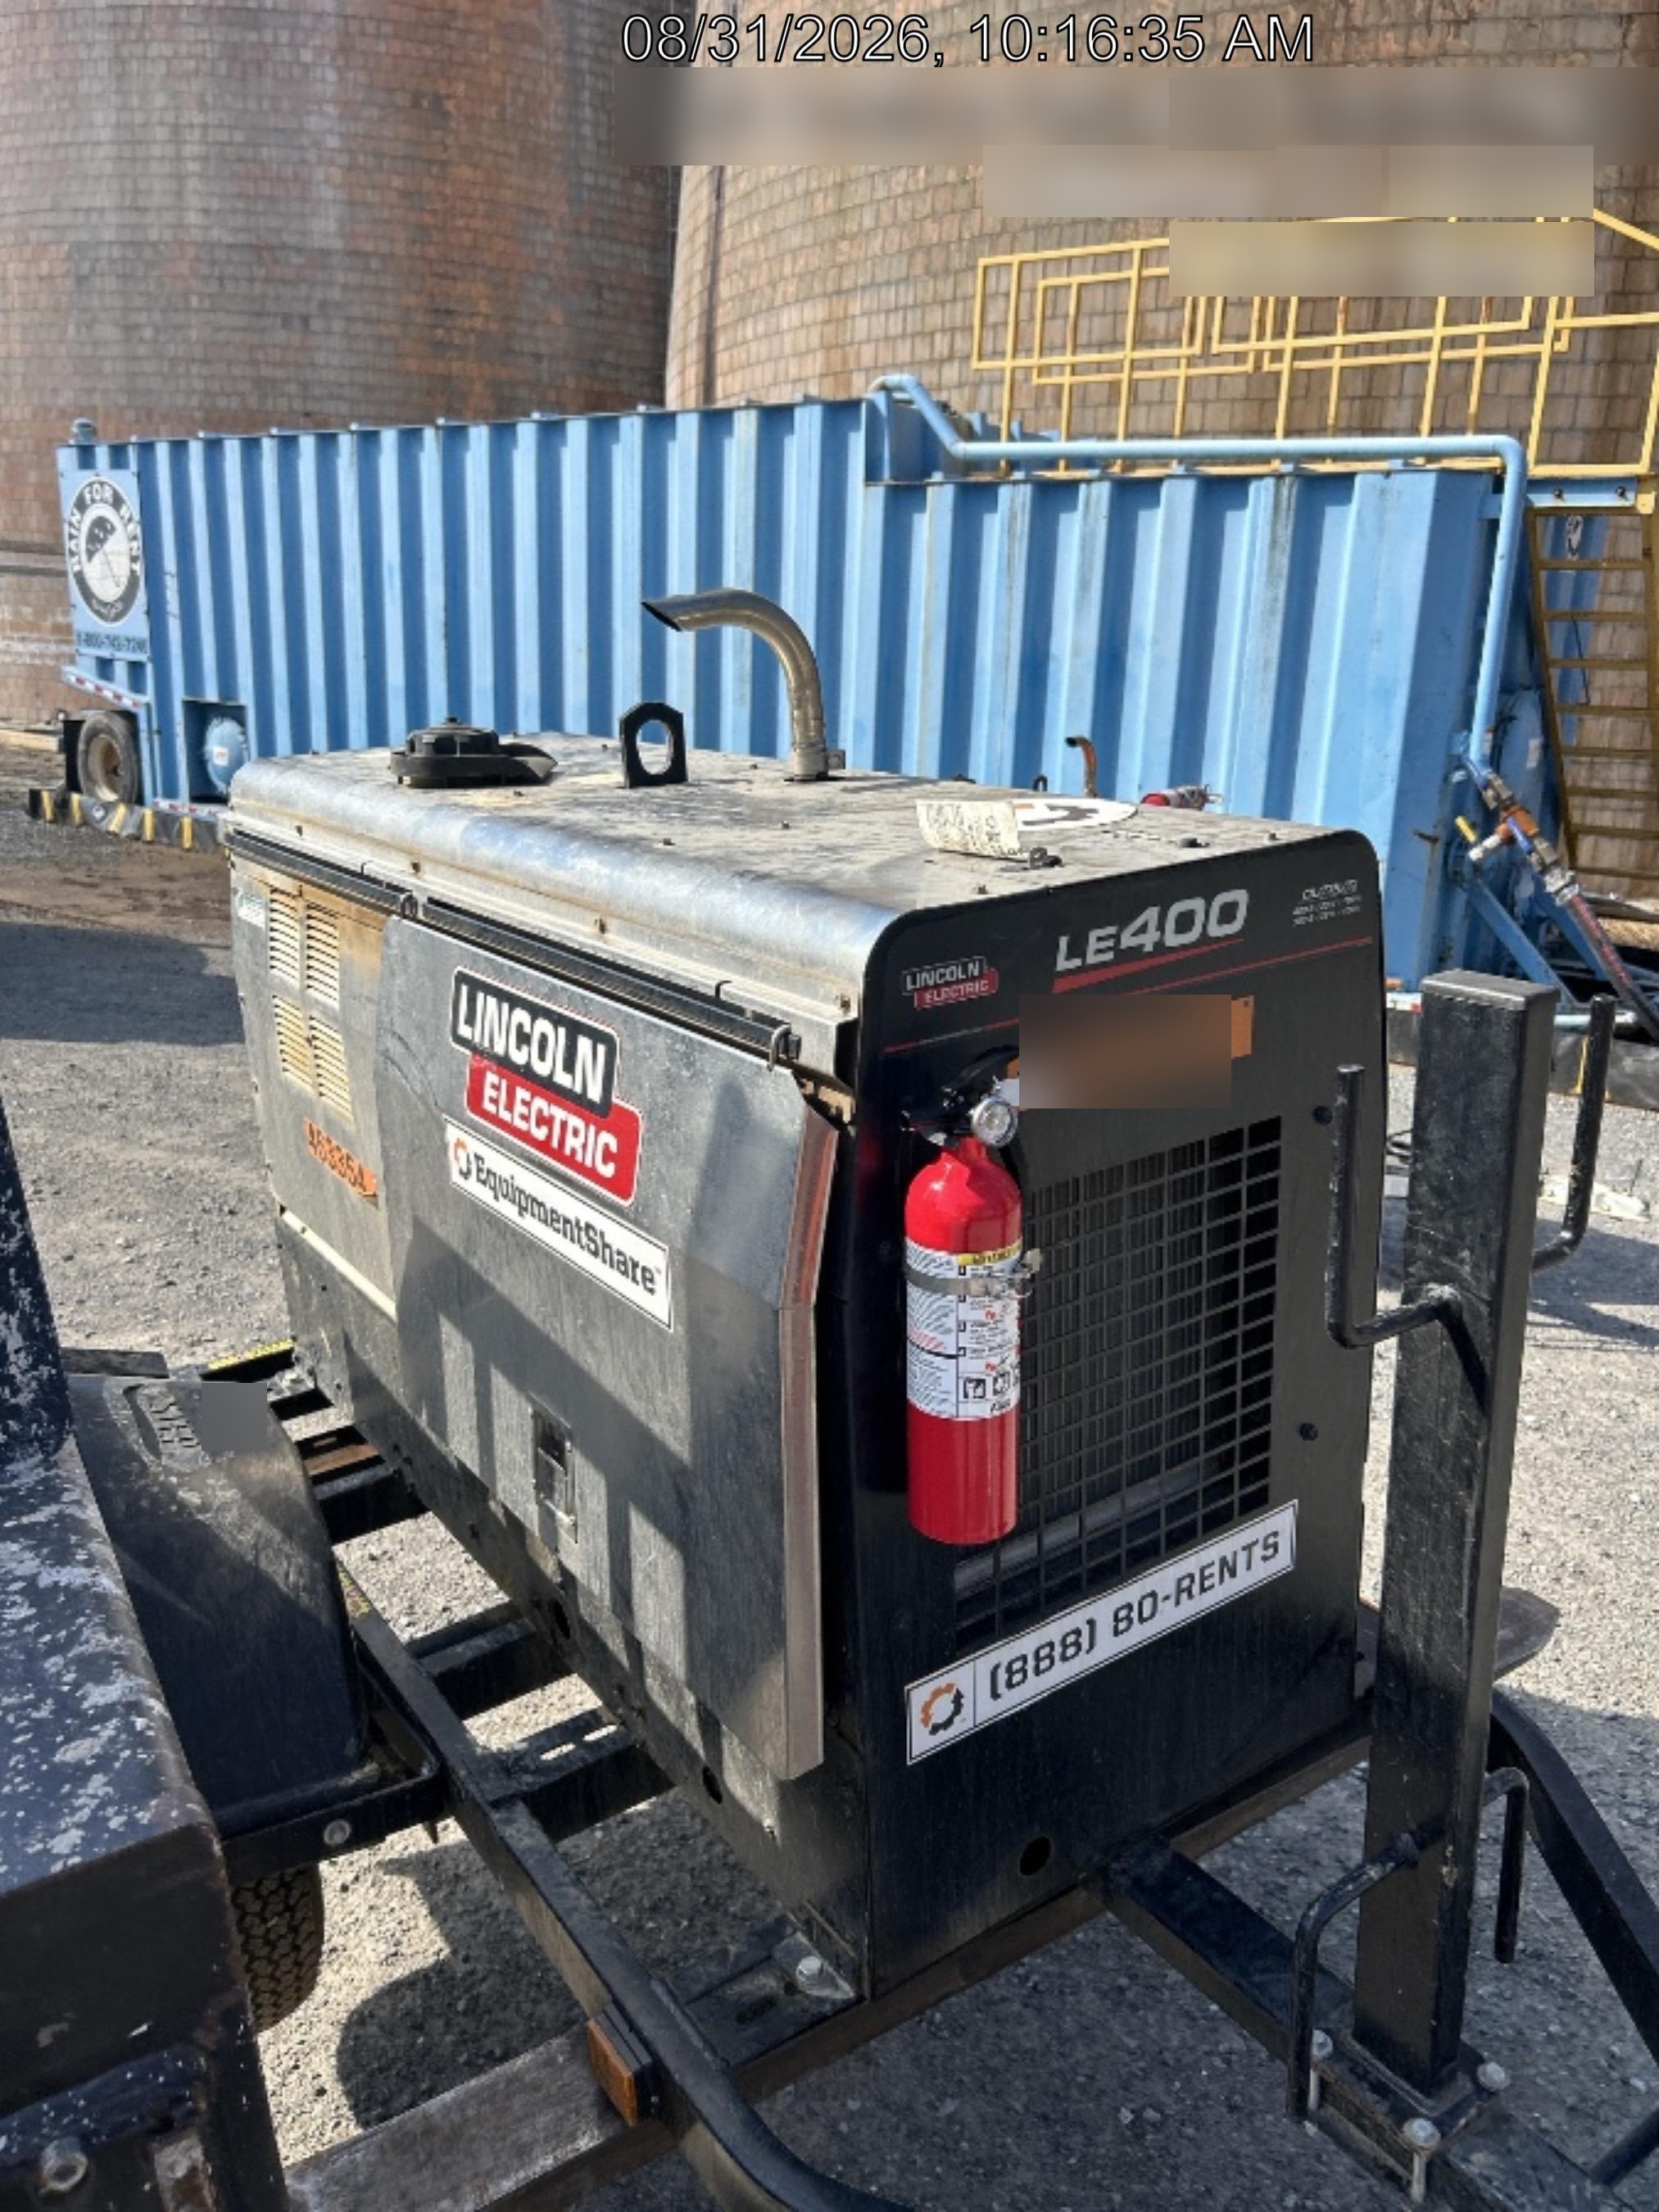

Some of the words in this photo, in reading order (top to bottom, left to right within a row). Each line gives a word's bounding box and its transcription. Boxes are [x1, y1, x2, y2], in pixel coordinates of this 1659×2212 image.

[84, 483, 114, 505] FOR
[1054, 889, 1249, 972] LE400
[905, 960, 980, 991] LINCOLN
[924, 980, 990, 1004] ELECTRIC
[456, 982, 605, 1104] LINCOLN
[481, 1070, 619, 1179] ELECTRIC
[473, 1154, 657, 1296] EquipmentShare
[989, 1618, 1096, 1701] (888)
